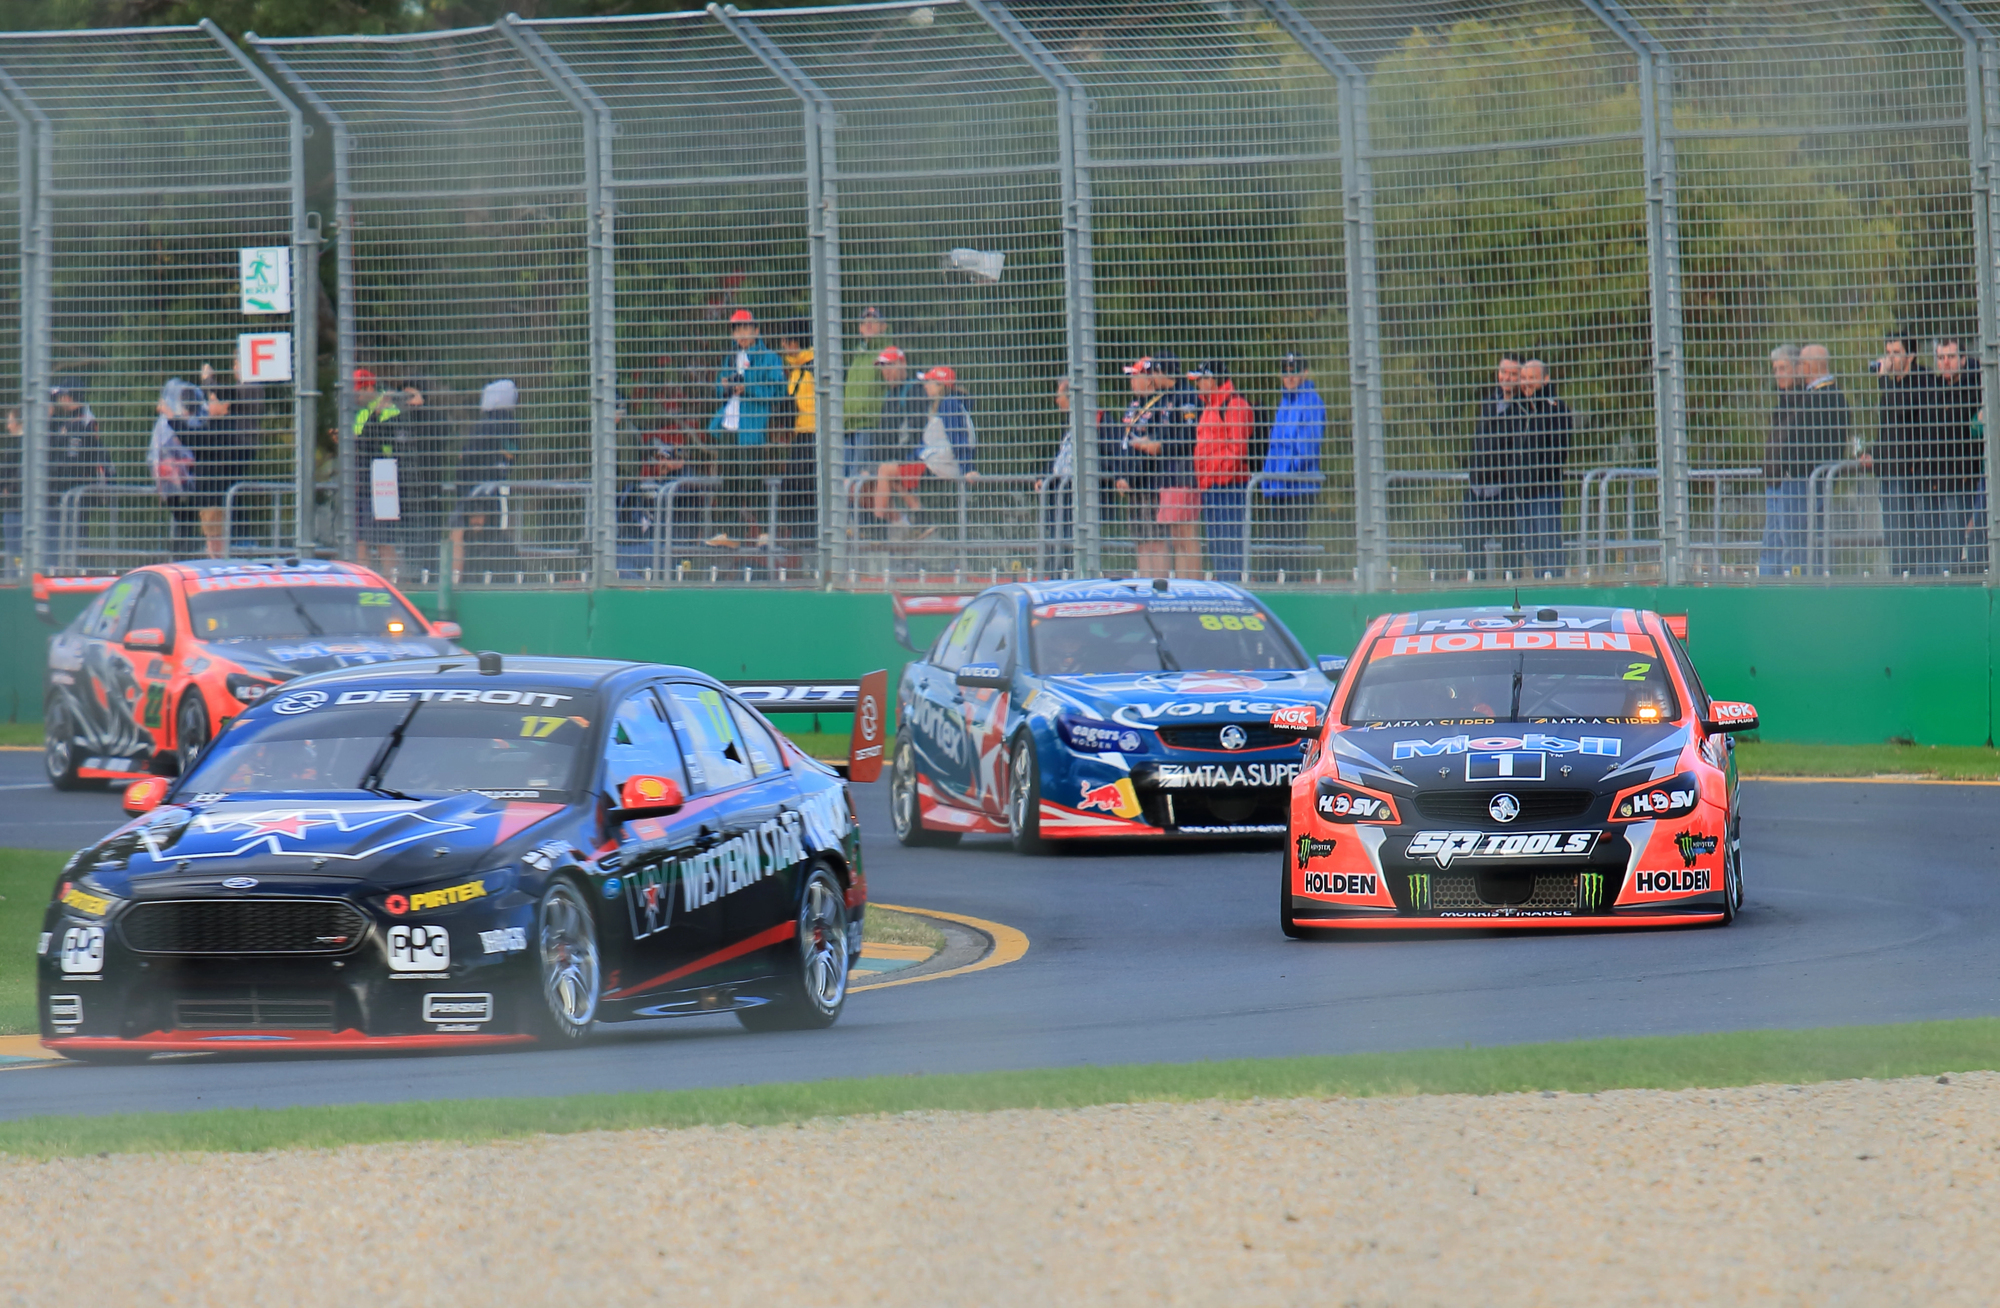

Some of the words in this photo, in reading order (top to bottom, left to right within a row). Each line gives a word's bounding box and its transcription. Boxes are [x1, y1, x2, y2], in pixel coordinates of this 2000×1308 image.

[245, 287, 277, 295] EXIT
[250, 338, 276, 376] F
[199, 574, 365, 590] HOLDEN
[358, 592, 392, 606] 22
[1199, 614, 1265, 631] 888
[1392, 632, 1631, 655] HOLDEN
[959, 667, 1001, 678] IVECO
[1622, 662, 1652, 681] 2
[334, 689, 574, 708] DETROIT
[1274, 710, 1311, 725] NGK
[1715, 703, 1753, 719] NGK
[519, 716, 569, 738] 17
[1072, 725, 1120, 741] eagers
[1071, 737, 1112, 749] HOLDEN
[1392, 733, 1622, 761] Mobil
[1490, 753, 1514, 776] 1
[1483, 834, 1592, 855] TOOLS
[679, 828, 762, 913] WESTERN
[1305, 872, 1377, 895] HOLDEN
[1636, 869, 1711, 893] HOLDEN
[409, 880, 488, 911] PIRTEK
[390, 926, 449, 967] PPG
